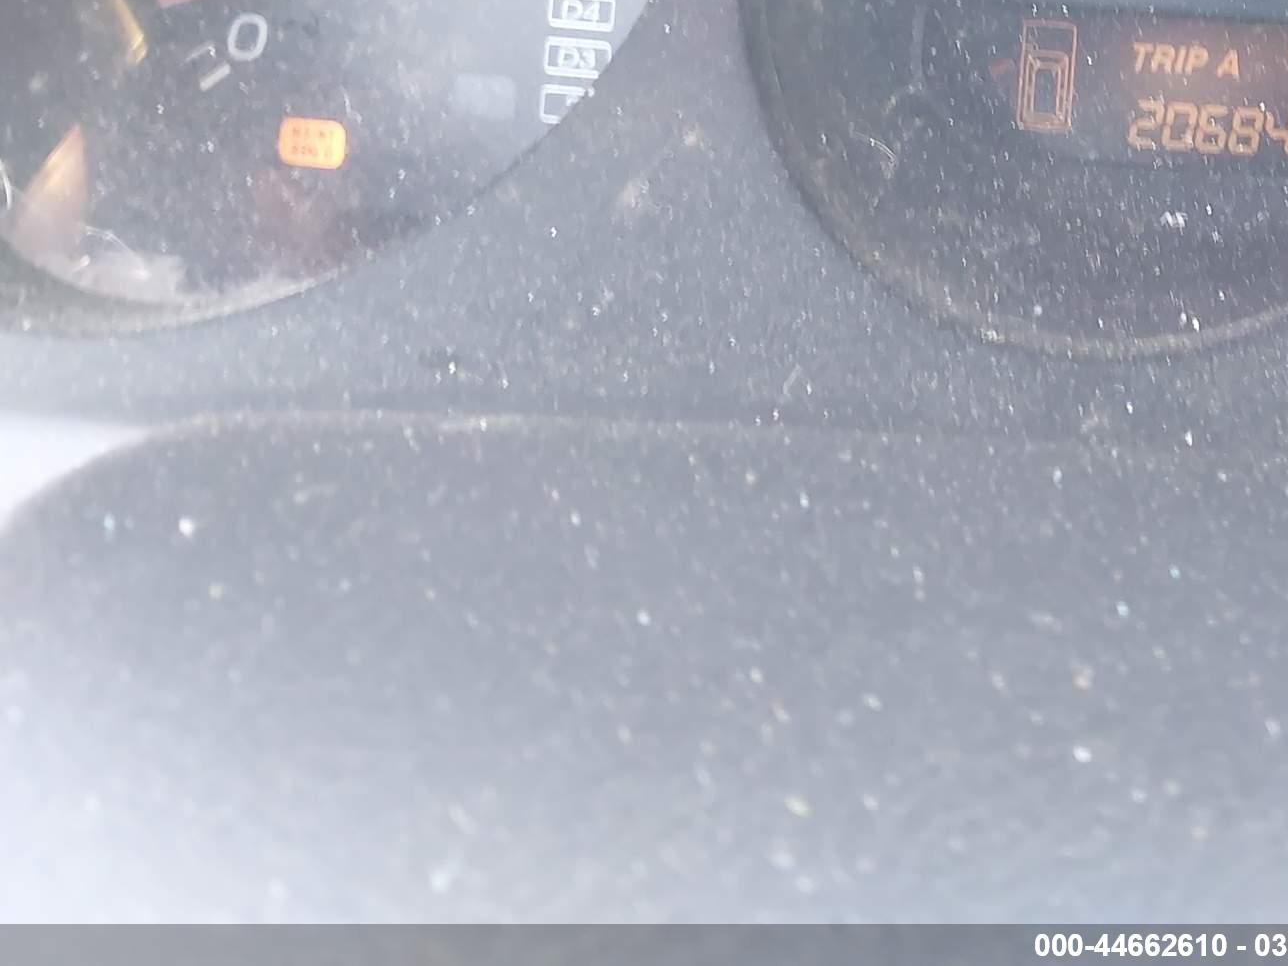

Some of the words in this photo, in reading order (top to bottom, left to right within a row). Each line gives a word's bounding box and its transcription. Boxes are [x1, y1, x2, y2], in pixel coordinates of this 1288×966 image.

[227, 13, 267, 61] 0
[557, 45, 597, 70] D3
[1133, 42, 1210, 75] TRIP
[1217, 48, 1241, 81] A
